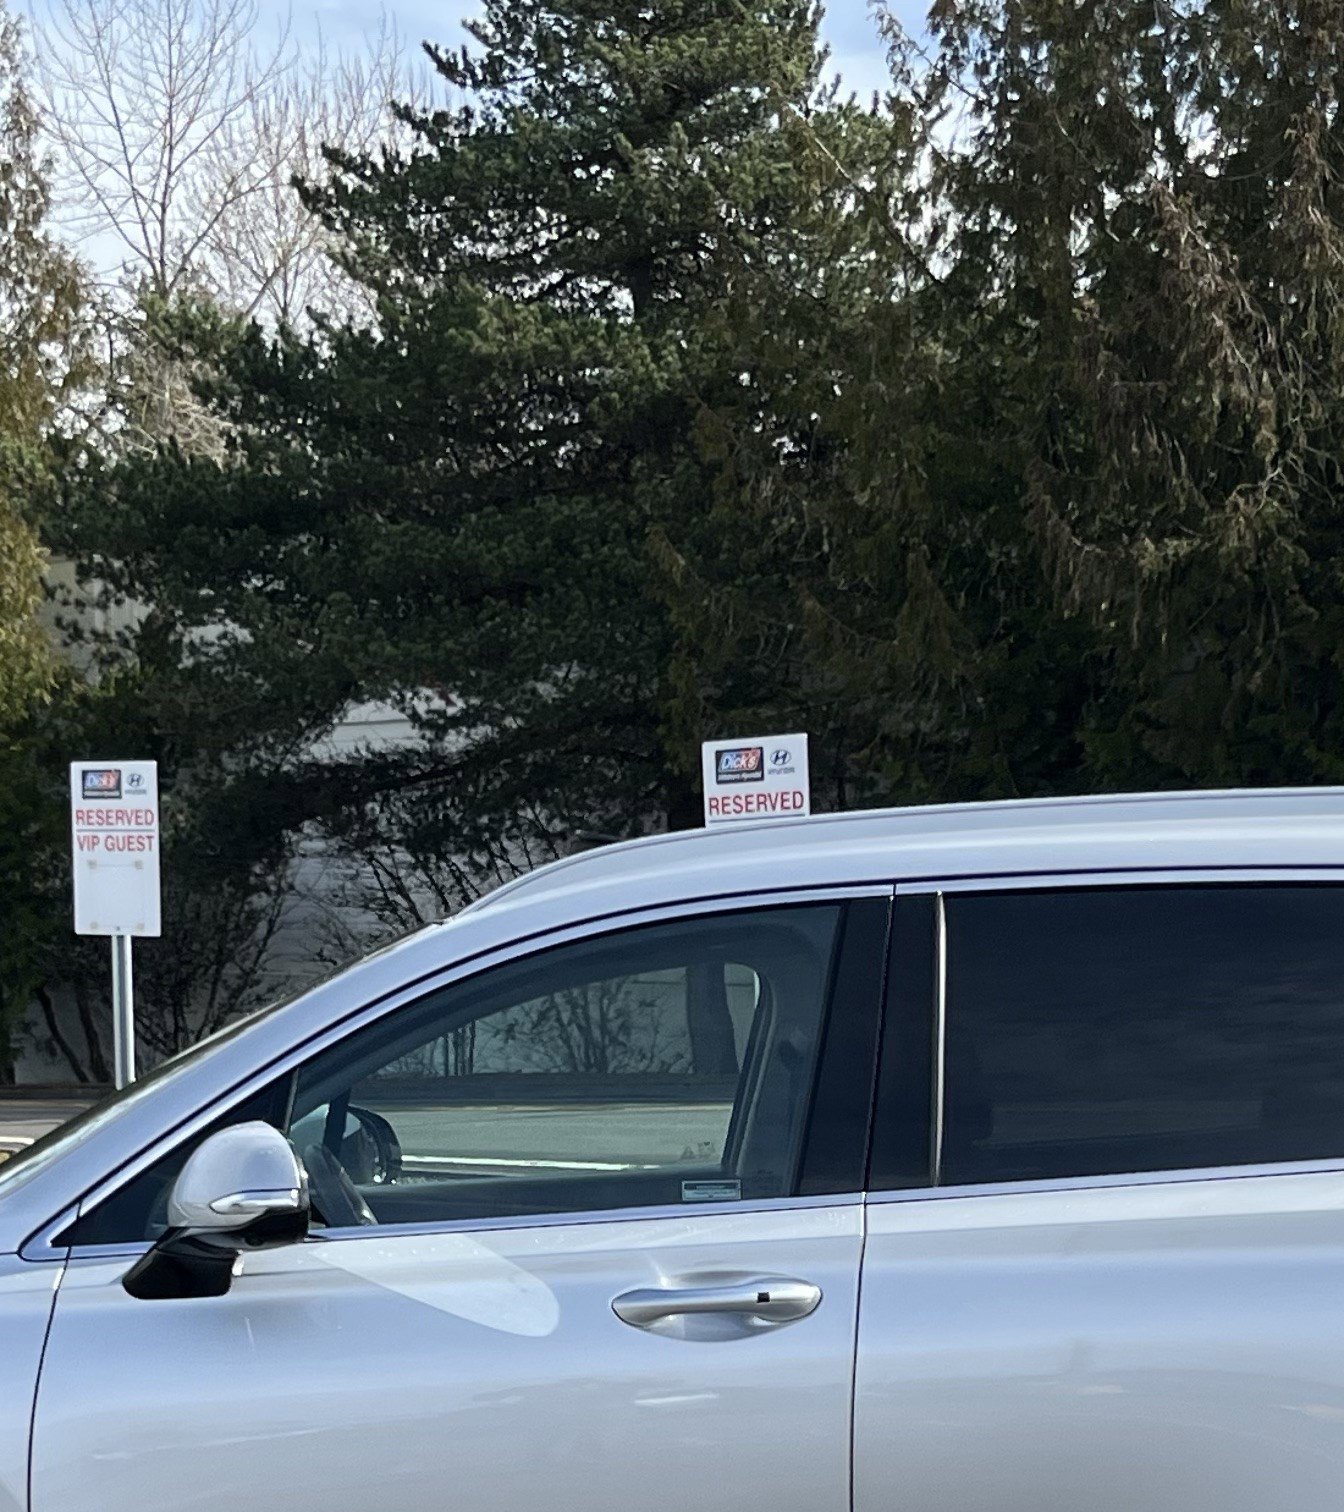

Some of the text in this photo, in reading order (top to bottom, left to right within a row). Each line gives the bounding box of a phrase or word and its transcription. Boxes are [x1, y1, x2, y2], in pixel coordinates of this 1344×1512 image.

[708, 790, 805, 816] RESERVED
[75, 809, 155, 826] RESERVED
[76, 835, 155, 851] VIP GUEST
